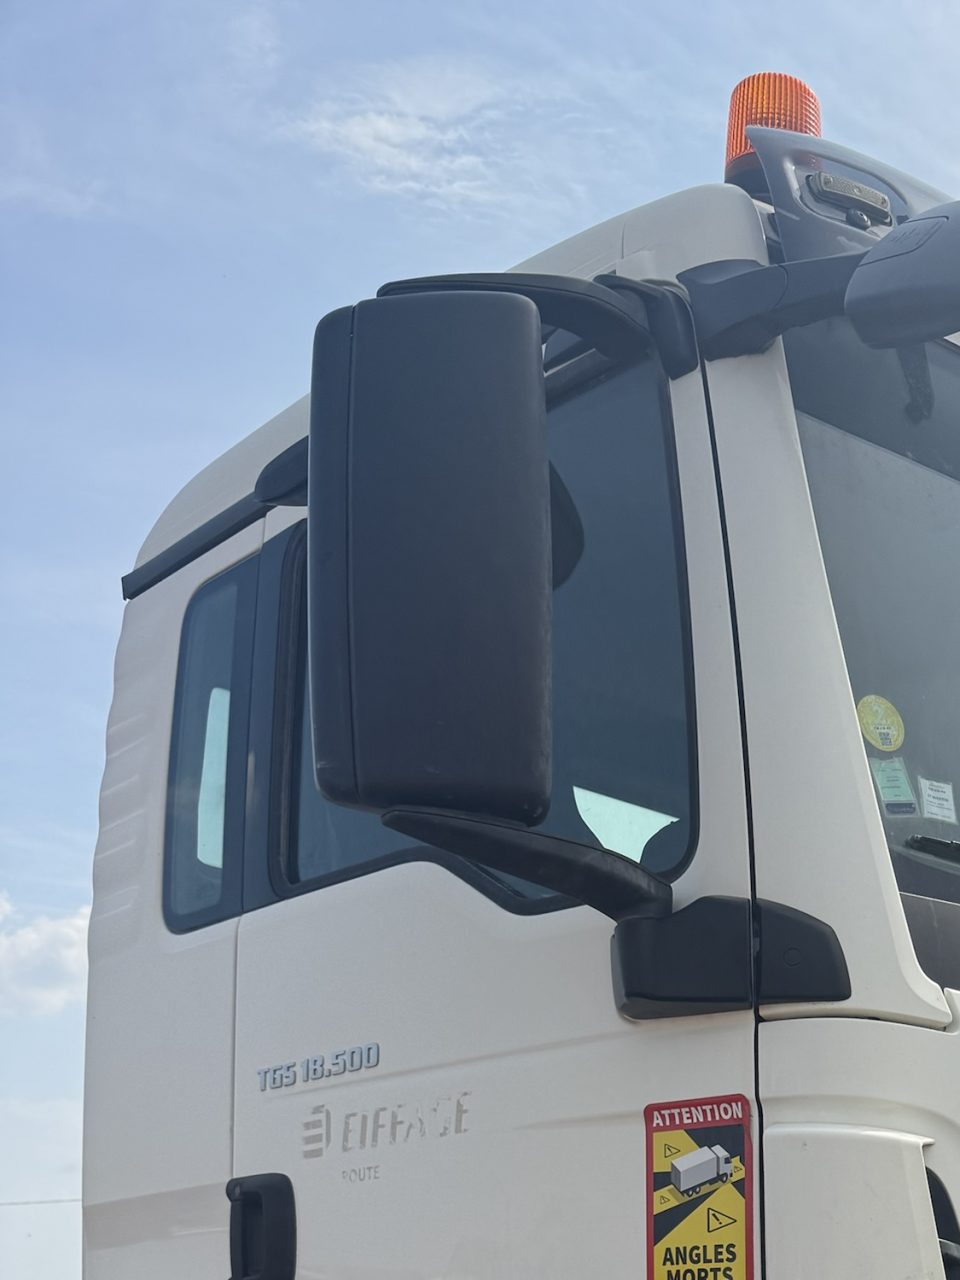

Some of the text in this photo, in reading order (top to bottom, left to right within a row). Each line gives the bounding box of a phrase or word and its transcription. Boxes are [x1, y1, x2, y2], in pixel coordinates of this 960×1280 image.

[257, 1042, 380, 1092] TGS 18.500
[652, 1101, 743, 1128] ATTENTION
[662, 1243, 737, 1266] ANGLES
